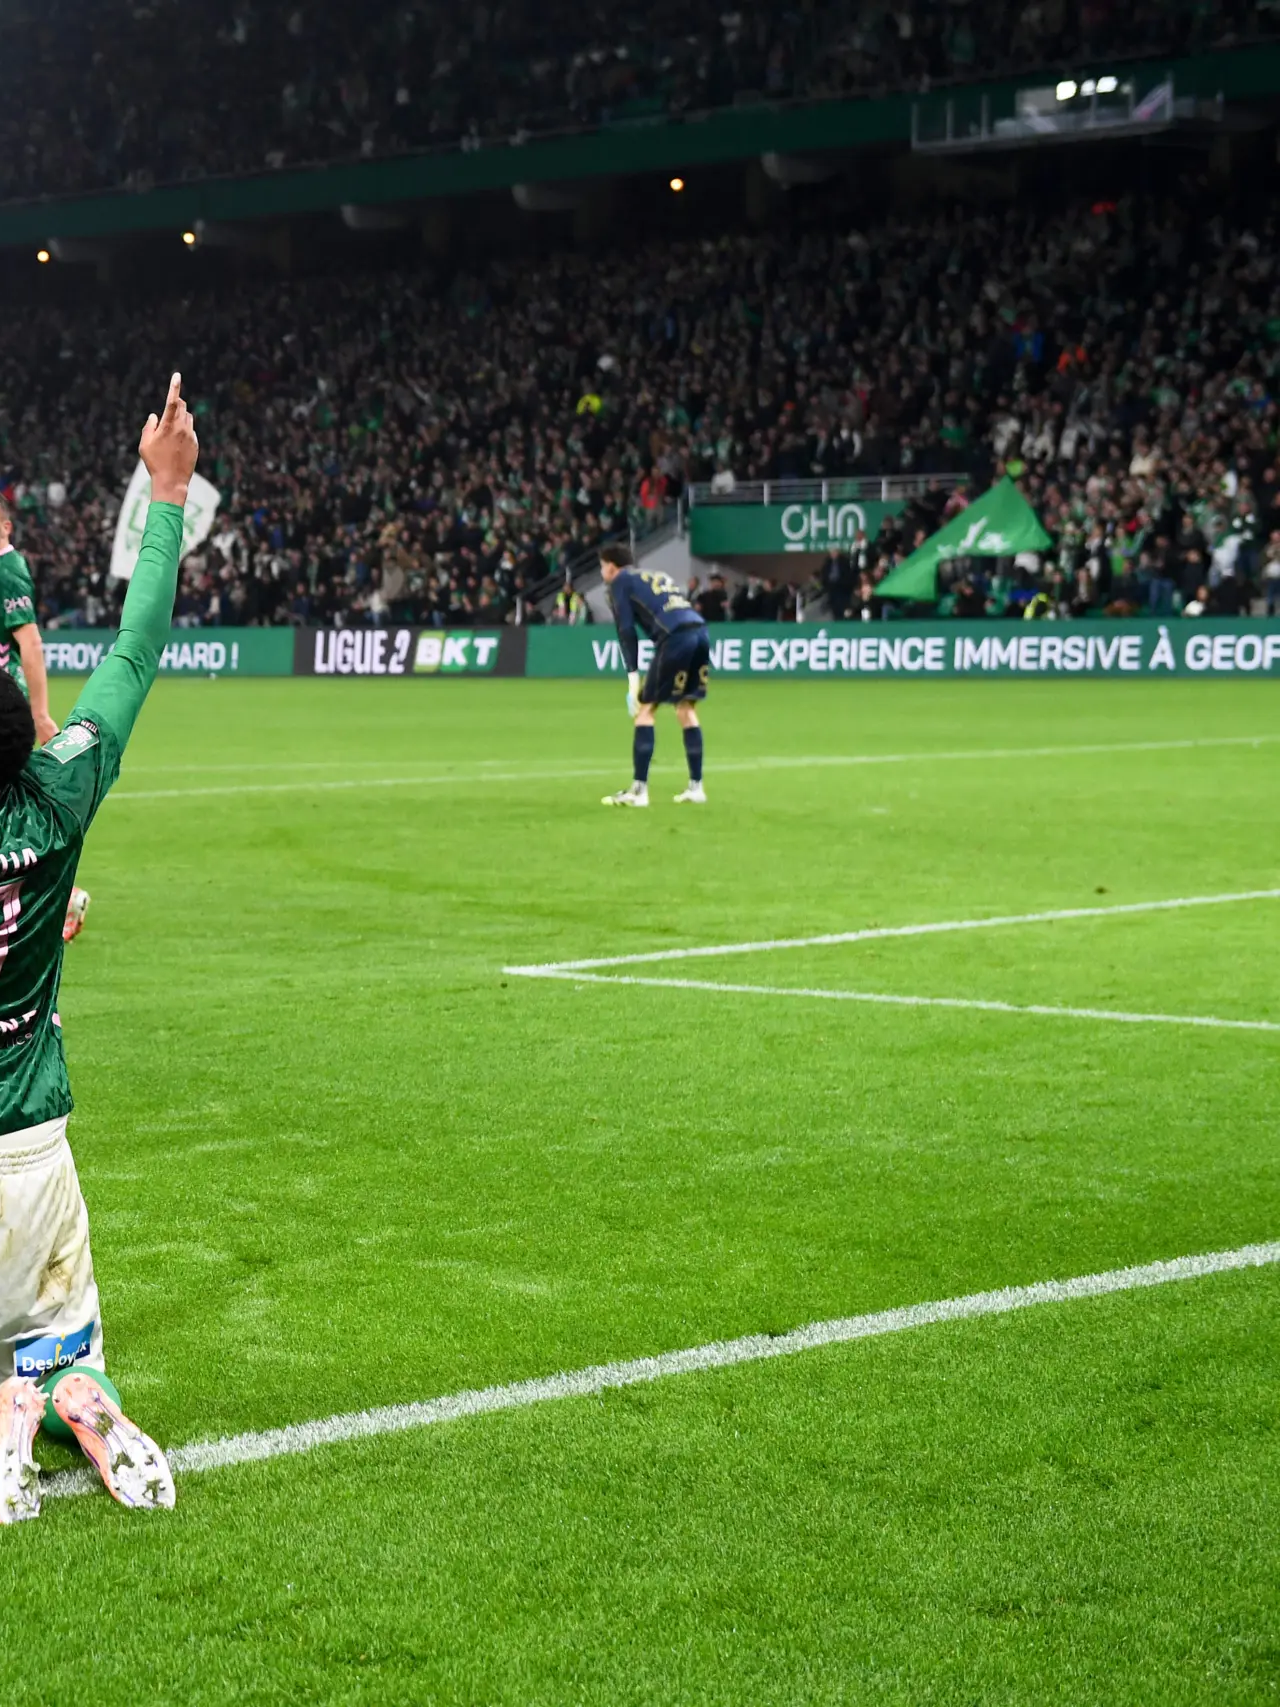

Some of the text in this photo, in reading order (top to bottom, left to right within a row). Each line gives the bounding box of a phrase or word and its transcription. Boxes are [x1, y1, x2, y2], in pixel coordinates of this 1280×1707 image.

[314, 629, 498, 674] LIGUE 2 BKT
[750, 628, 947, 671] EXPÉRIENCE
[954, 636, 1143, 671] IMMERSIVE
[1148, 625, 1176, 670] À
